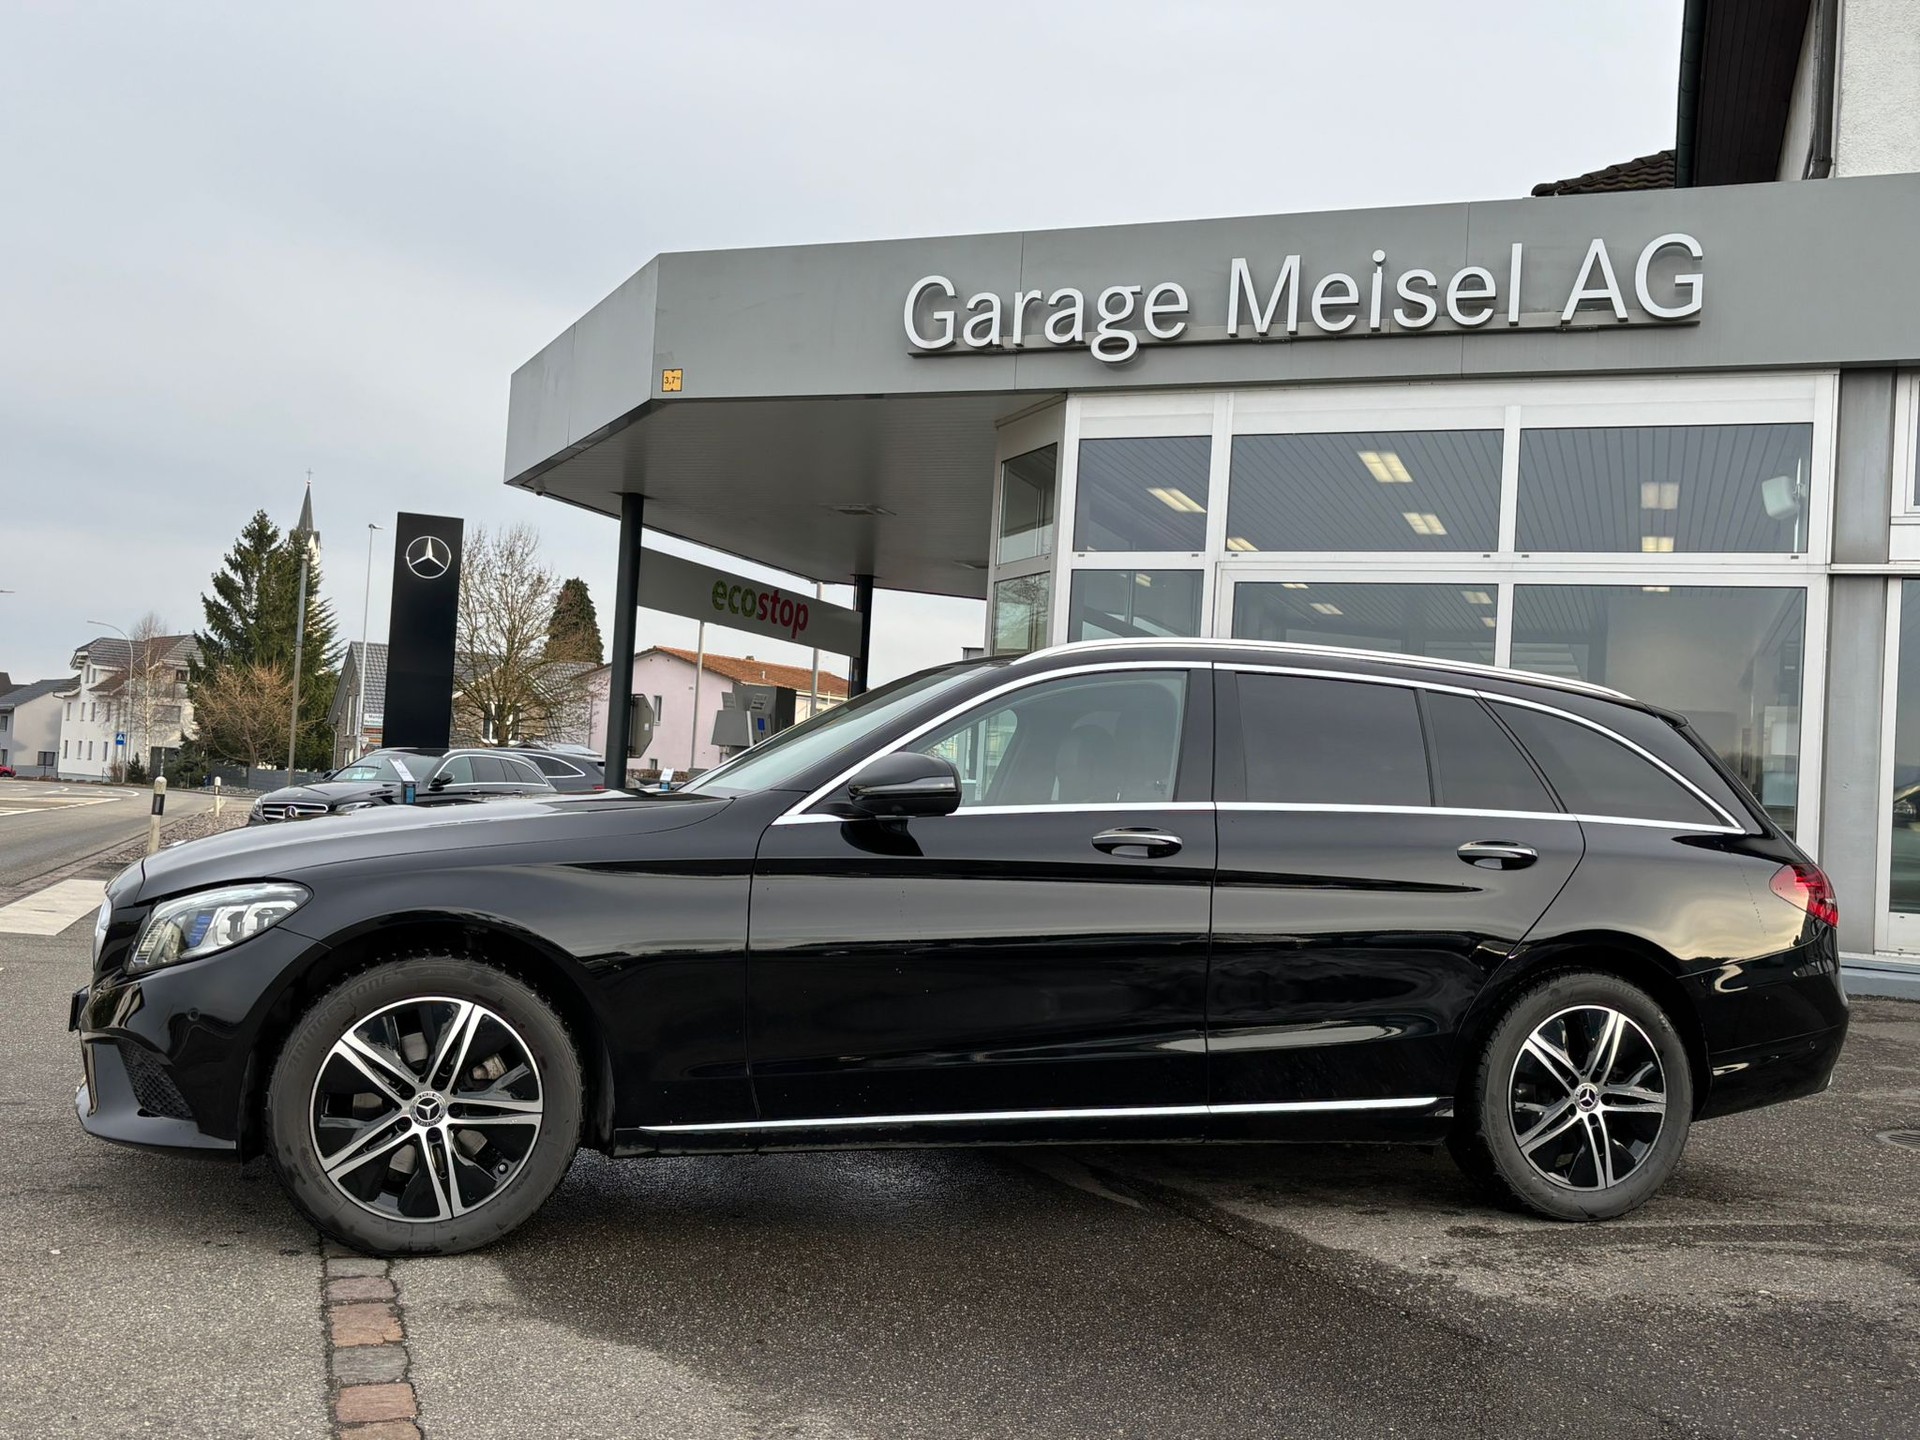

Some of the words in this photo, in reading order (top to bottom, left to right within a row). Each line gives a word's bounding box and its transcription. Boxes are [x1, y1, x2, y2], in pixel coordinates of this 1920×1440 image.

[904, 275, 1190, 363] Garage
[1227, 243, 1522, 337] Meisel
[1561, 233, 1704, 323] AG
[712, 579, 809, 639] ecostop
